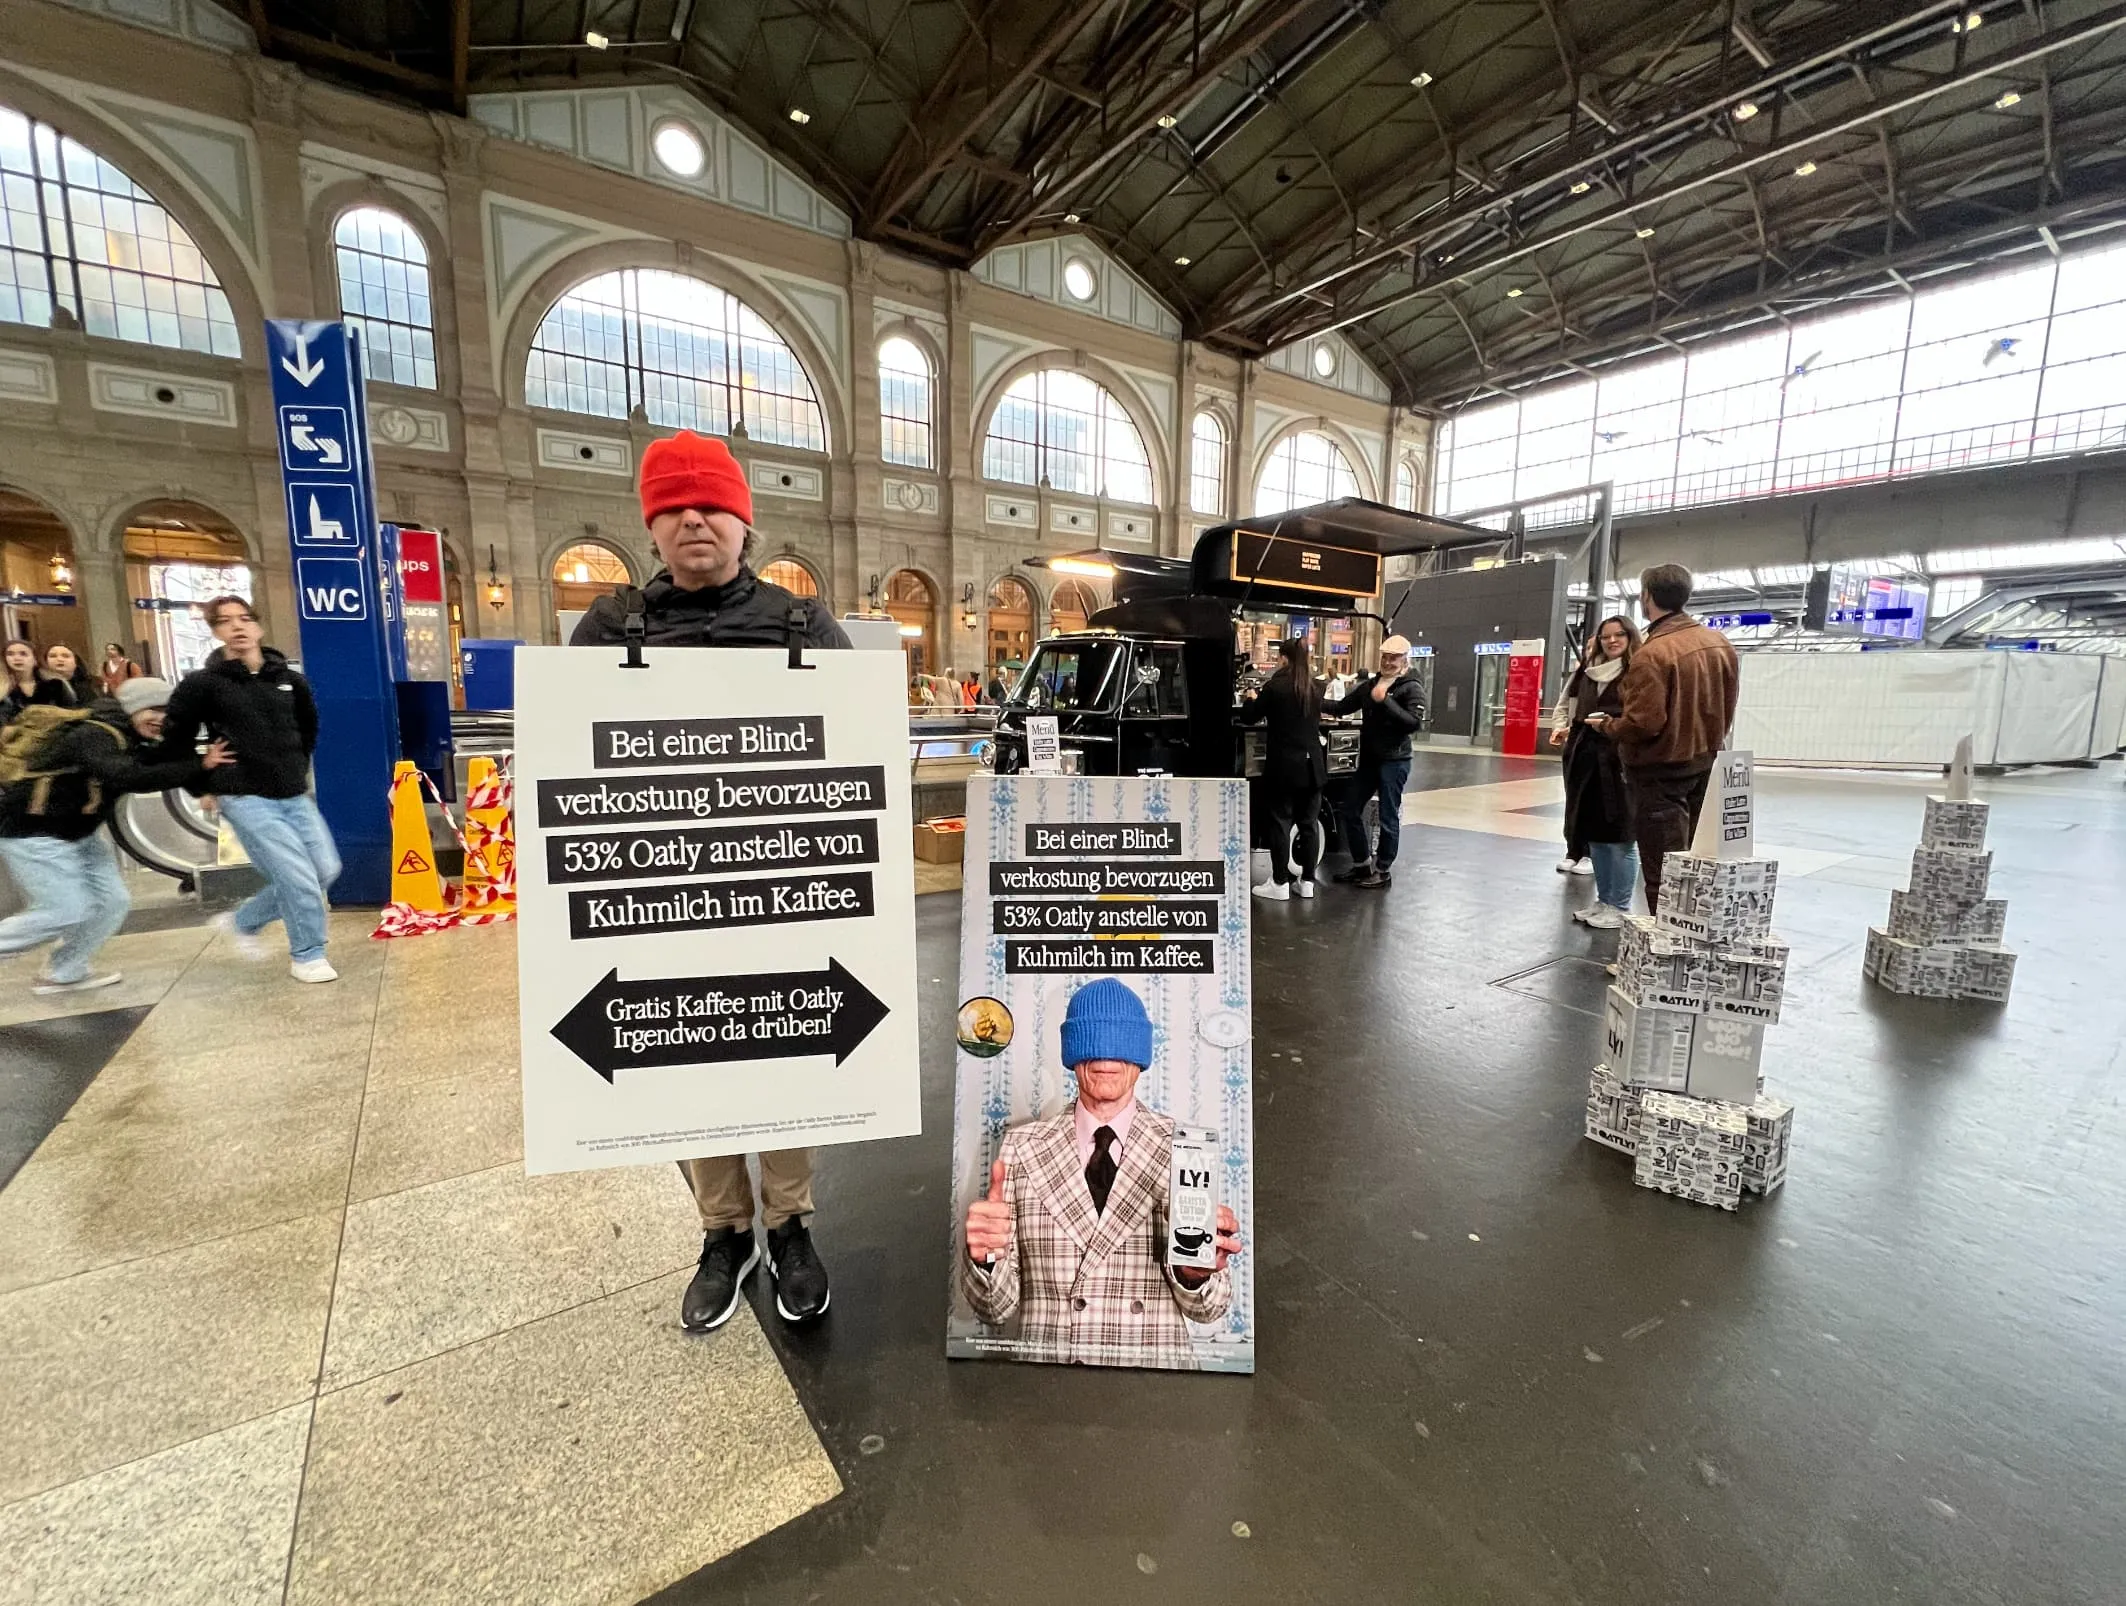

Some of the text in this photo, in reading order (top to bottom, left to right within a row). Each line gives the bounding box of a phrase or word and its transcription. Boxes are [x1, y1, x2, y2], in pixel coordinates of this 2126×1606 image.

[289, 413, 308, 423] SOS
[306, 587, 360, 613] WC
[610, 723, 815, 759] Bei einer Blind-
[1723, 765, 1750, 788] Menü
[556, 777, 872, 818] verkostung bevorzugen
[1035, 827, 1175, 850] Bei einer Blind-
[563, 831, 864, 872] 53% Oatly anstelle von
[1000, 865, 1215, 893] verkostung bevorzugen
[587, 880, 861, 928] Kuhmilch im Kaffee.
[1003, 904, 1208, 932] 53% Oatly anstelle von
[1669, 916, 1705, 934] OATLY!
[1016, 944, 1204, 968] Kuhmilch im Kaffee.
[605, 985, 844, 1023] Gratis Kaffee mit Oatly.
[1658, 994, 1700, 1008] OATLY!
[1724, 1002, 1771, 1018] OATLY!
[612, 1013, 832, 1054] Irgendwo da drüben!
[1598, 1129, 1636, 1150] OATLY!
[1179, 1169, 1210, 1188] LY!
